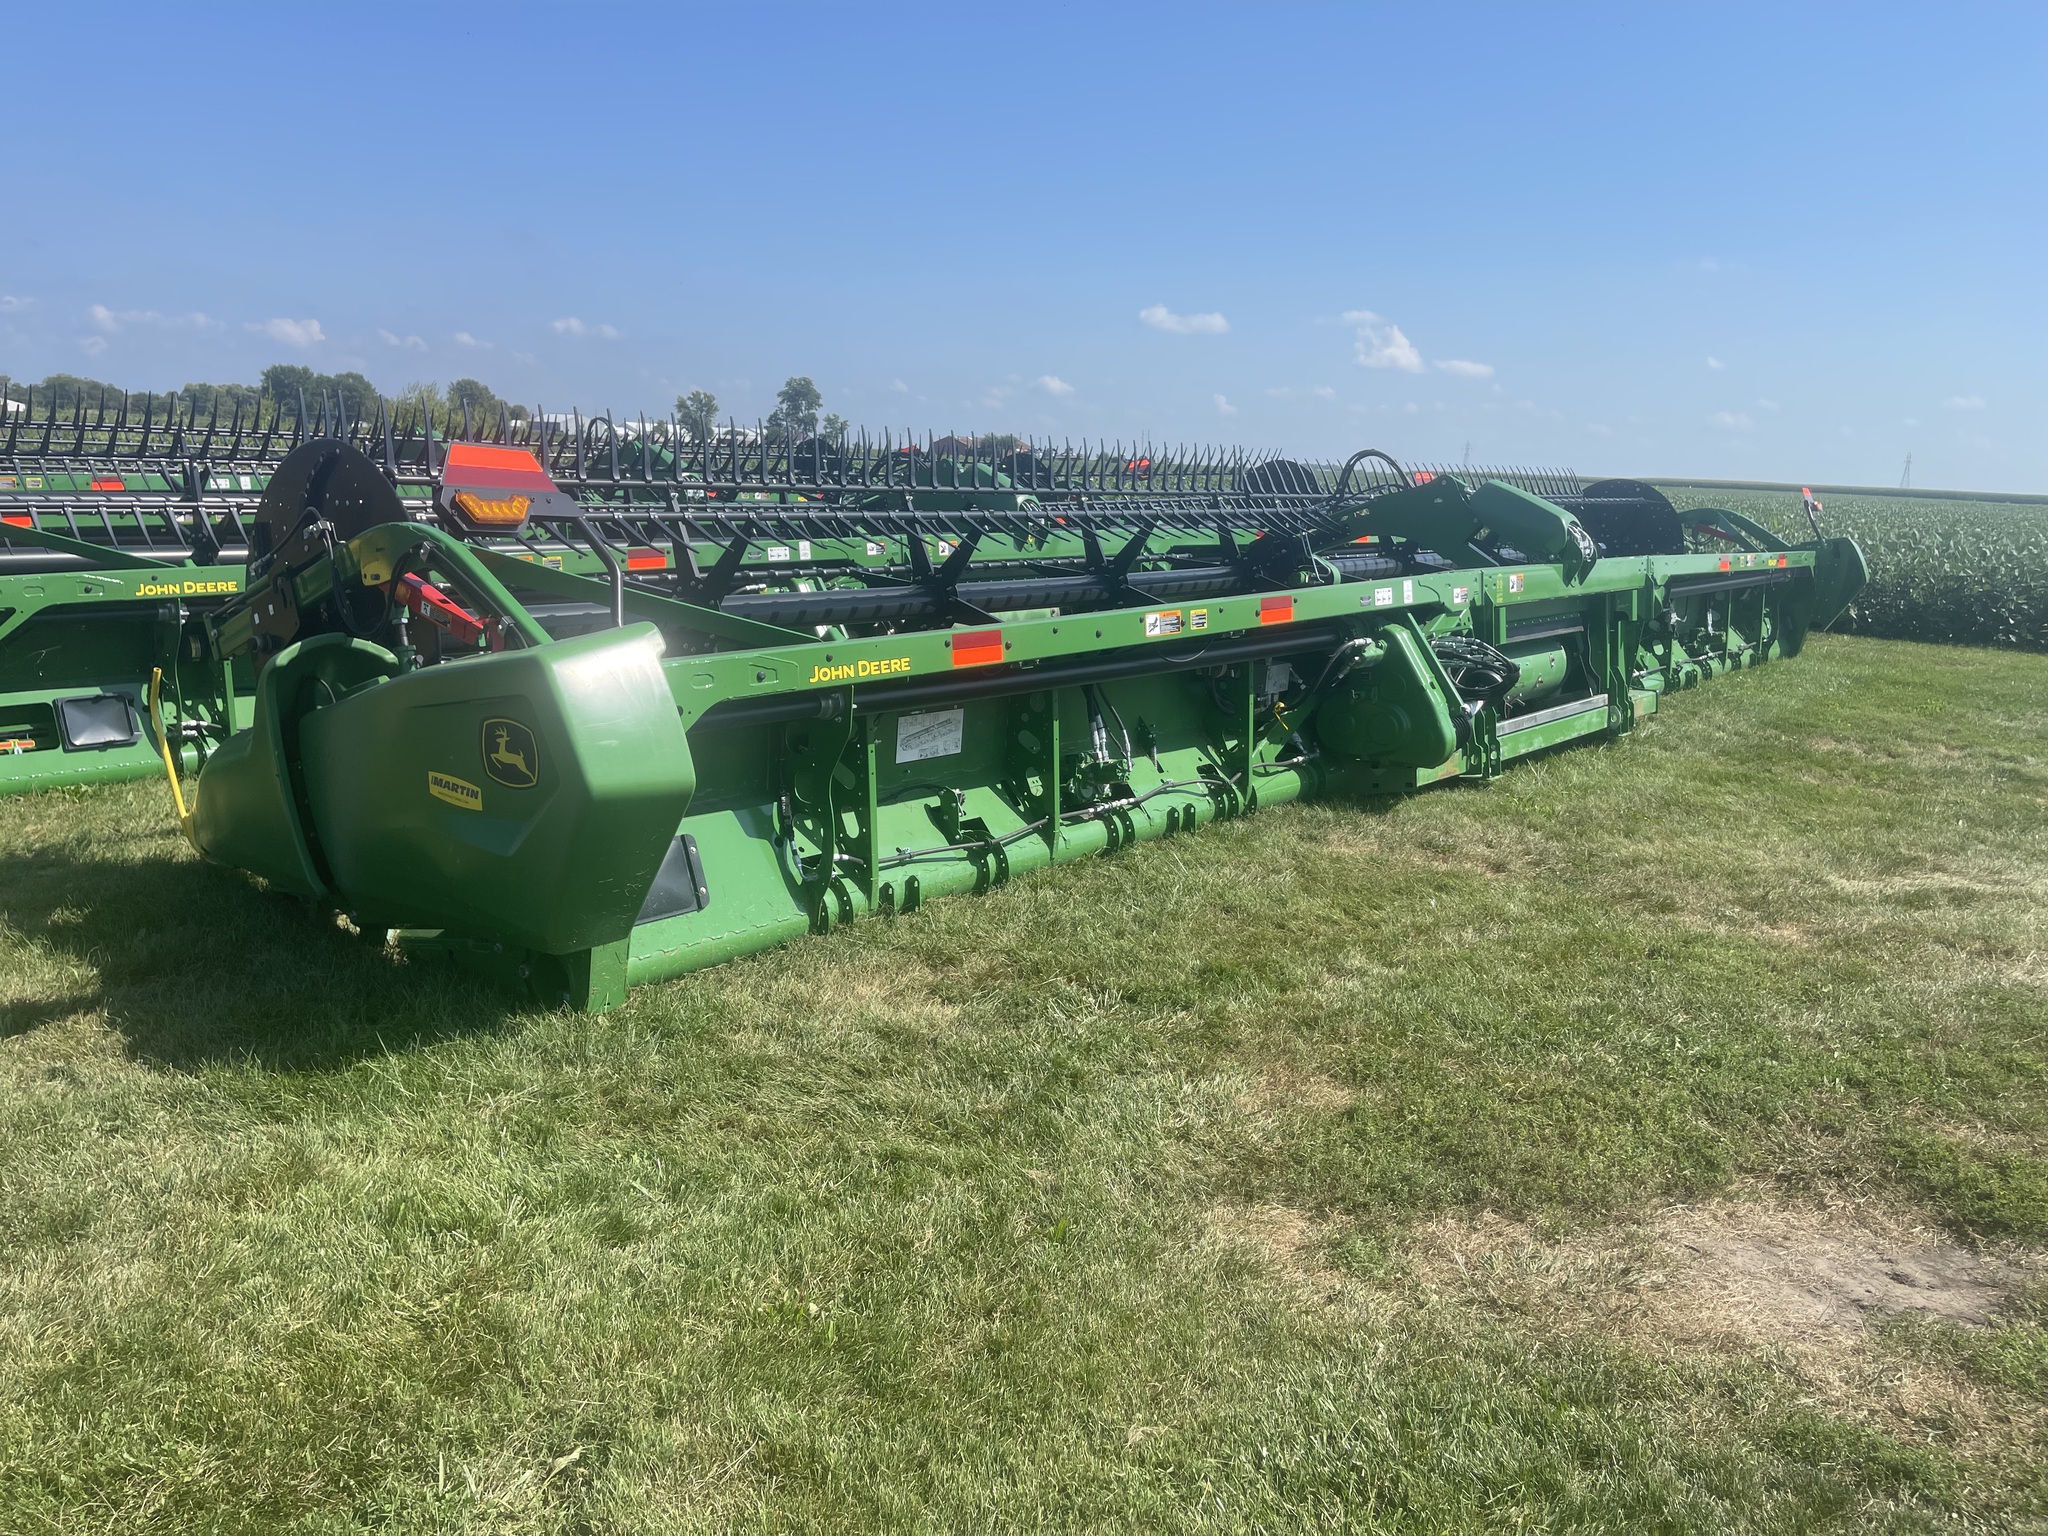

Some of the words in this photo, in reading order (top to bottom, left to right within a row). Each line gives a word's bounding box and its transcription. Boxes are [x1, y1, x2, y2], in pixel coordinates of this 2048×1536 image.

[135, 583, 181, 597] JOHN
[183, 581, 238, 594] DEERE
[809, 665, 855, 683] JOHN
[857, 657, 911, 677] DEERE
[431, 775, 479, 800] MARTIN
